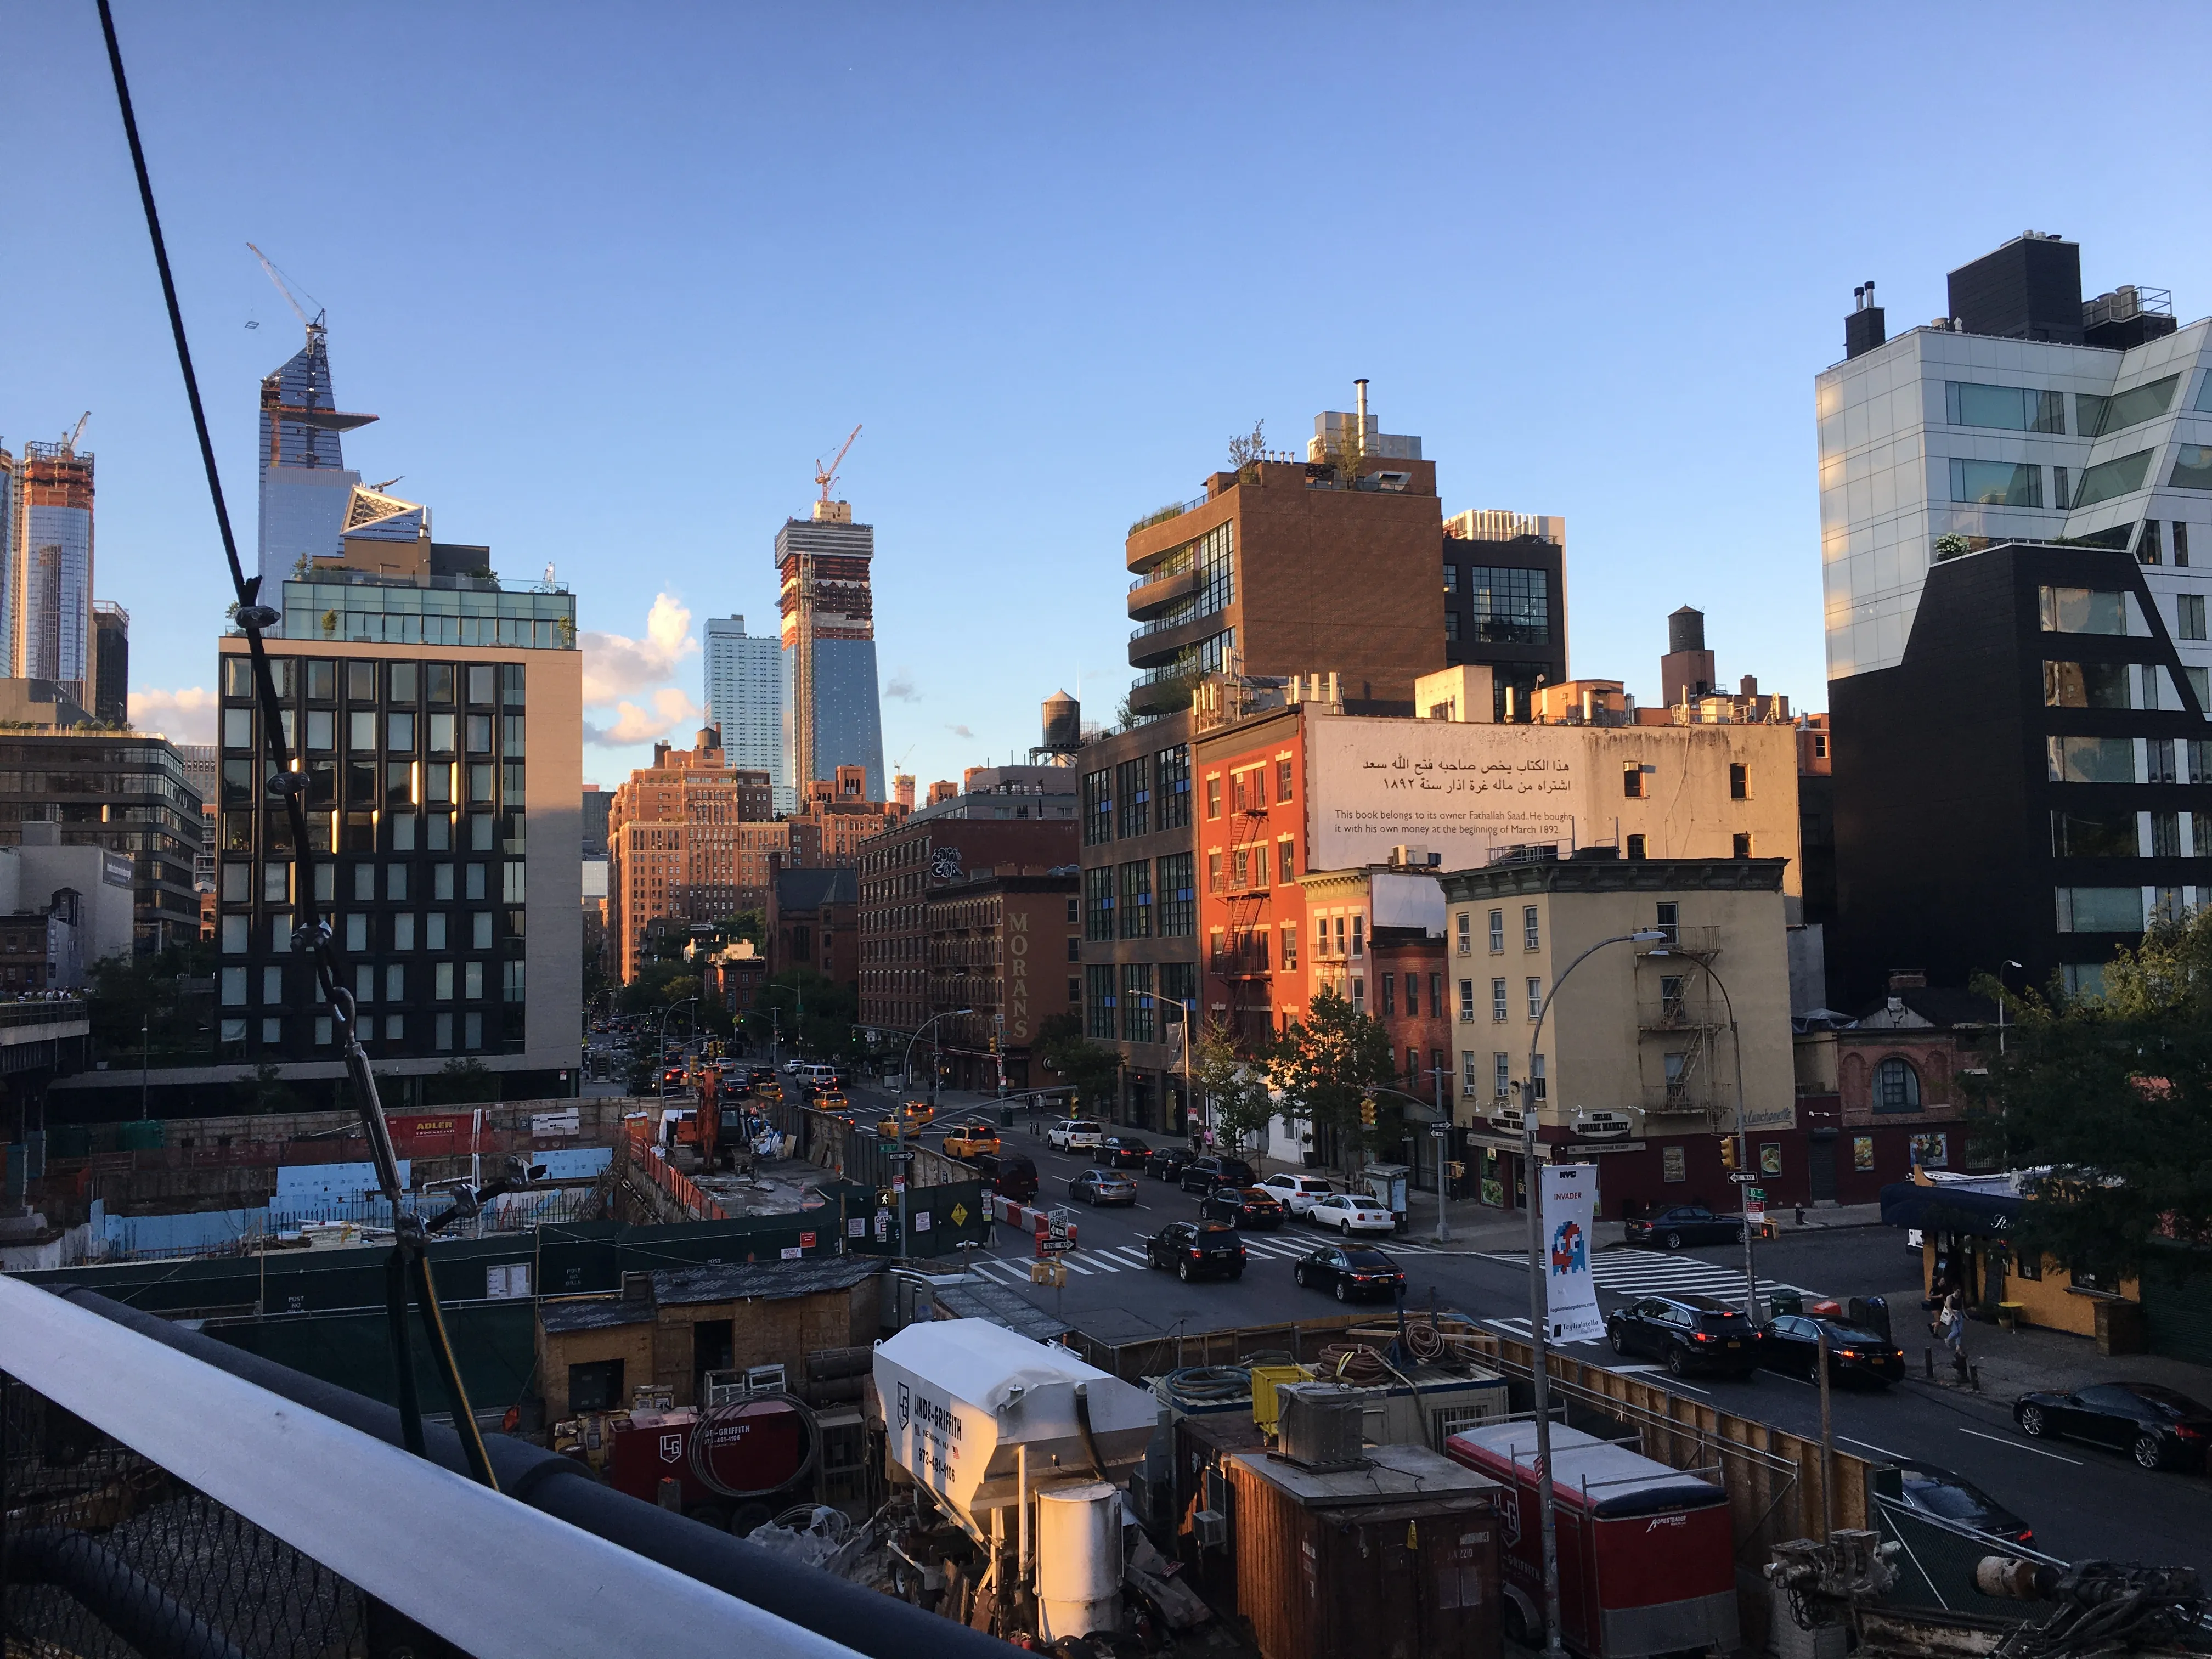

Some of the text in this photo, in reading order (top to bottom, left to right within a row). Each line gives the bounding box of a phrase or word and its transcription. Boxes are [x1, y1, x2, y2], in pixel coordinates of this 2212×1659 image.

[1414, 759, 1433, 775] فتح
[1438, 759, 1476, 773] صاحبه
[1481, 760, 1511, 774] يخص
[1516, 759, 1549, 775] الكتاب
[1553, 759, 1570, 771] هذا
[1384, 777, 1570, 794] اشتراه من ماله غرة اذار سنة ١٨٩٢
[1335, 810, 1353, 819] This
[1356, 810, 1378, 819] book
[1380, 810, 1412, 821] belongs
[1469, 811, 1504, 820] Fathallah
[1530, 812, 1542, 820] He
[1544, 812, 1573, 822] bought
[1335, 824, 1341, 833] it
[1344, 824, 1362, 833] with
[1365, 824, 1377, 833] his
[1401, 826, 1429, 835] money
[1443, 825, 1456, 833] the
[1459, 825, 1498, 836] beginning
[1500, 825, 1509, 833] of
[1511, 825, 1536, 834] March
[1554, 1192, 1582, 1200] INVADER
[915, 1393, 962, 1441] LINDE-GRIFFITH
[918, 1447, 955, 1483] 973-481-1106
